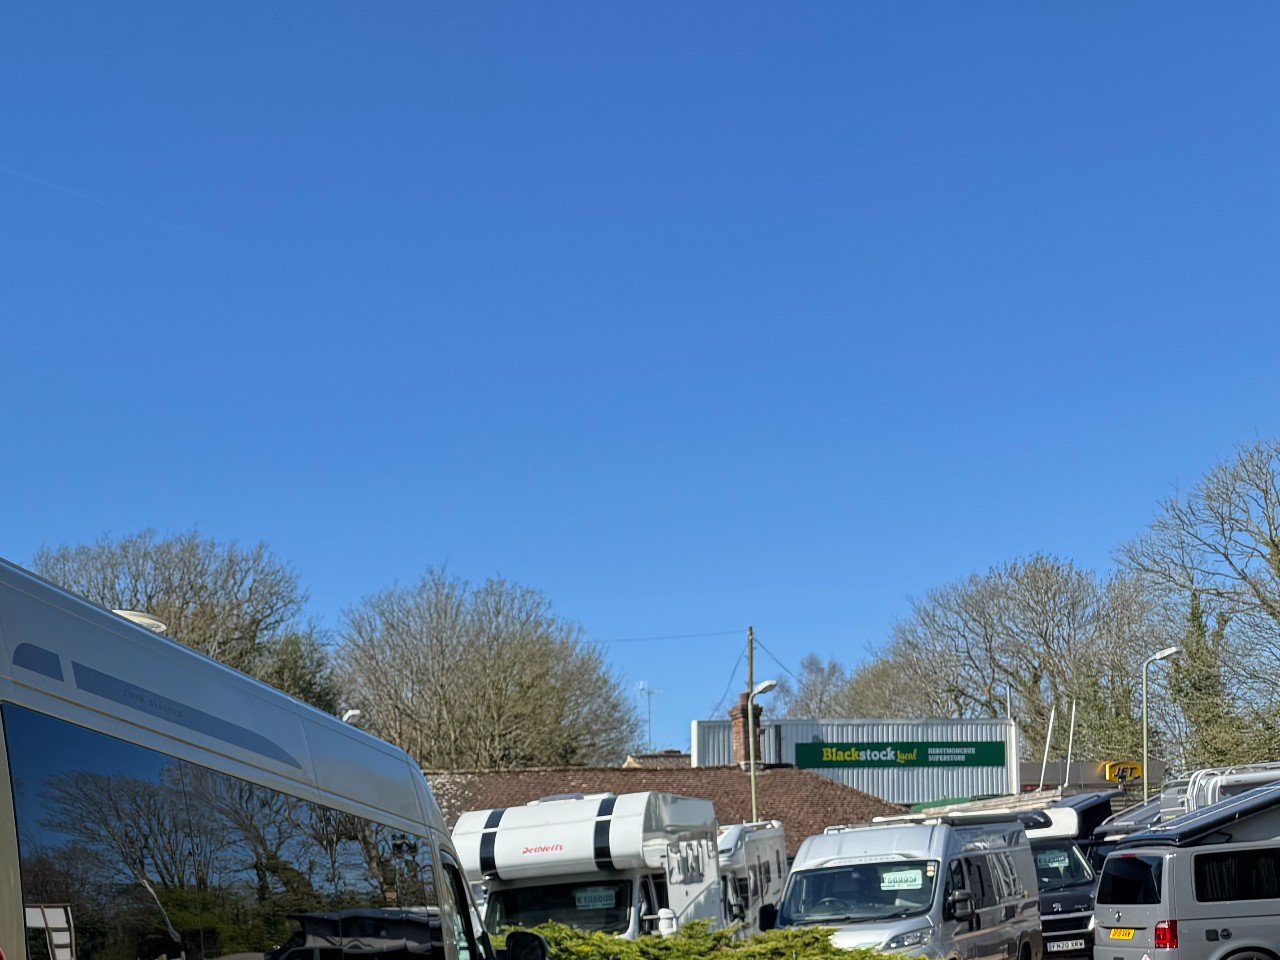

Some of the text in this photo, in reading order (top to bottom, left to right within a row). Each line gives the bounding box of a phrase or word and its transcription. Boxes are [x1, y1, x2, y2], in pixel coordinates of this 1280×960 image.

[822, 746, 895, 762] Blackstock
[928, 754, 966, 762] SUPERSTORE
[1113, 766, 1137, 778] JET
